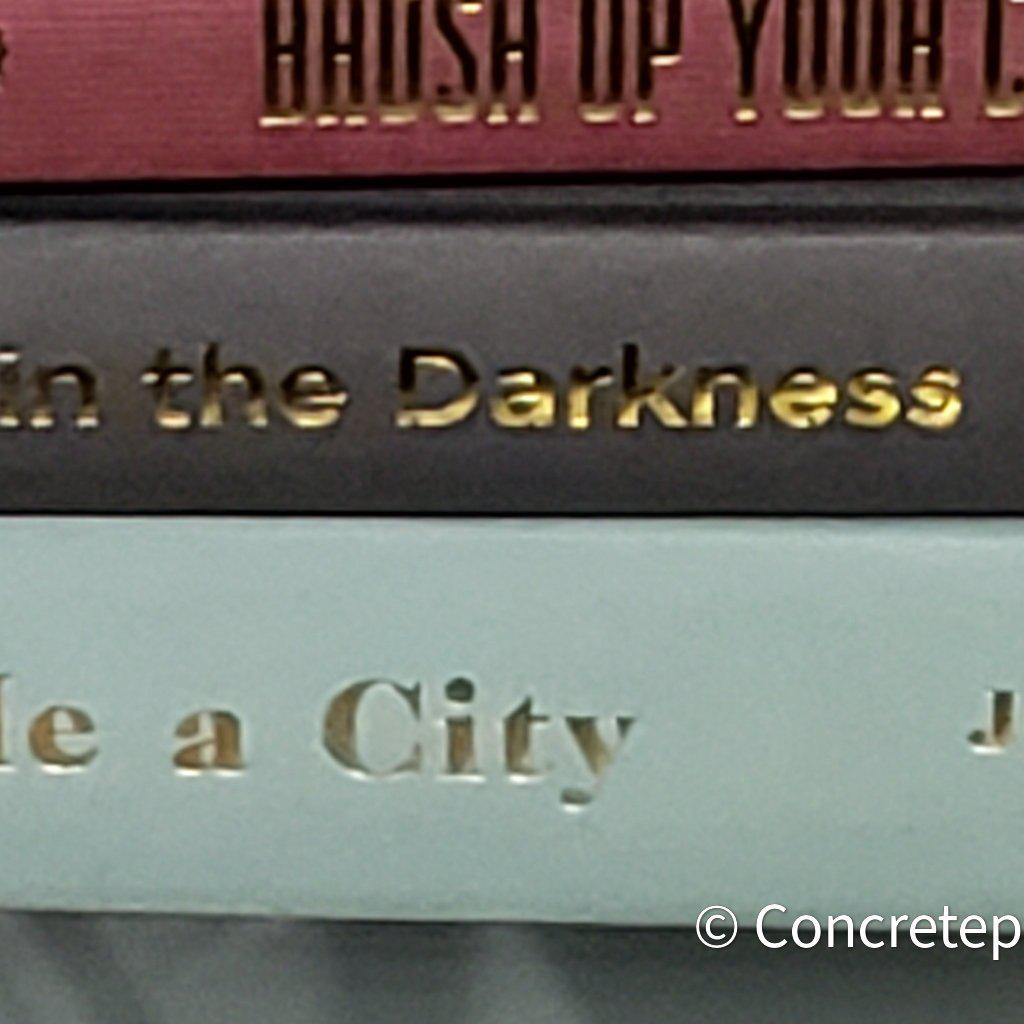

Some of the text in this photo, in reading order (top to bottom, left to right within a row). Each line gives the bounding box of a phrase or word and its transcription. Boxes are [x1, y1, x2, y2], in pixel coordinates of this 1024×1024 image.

[140, 342, 349, 429] the
[396, 342, 965, 430] Darkness
[171, 709, 246, 777] a
[320, 677, 637, 813] City
